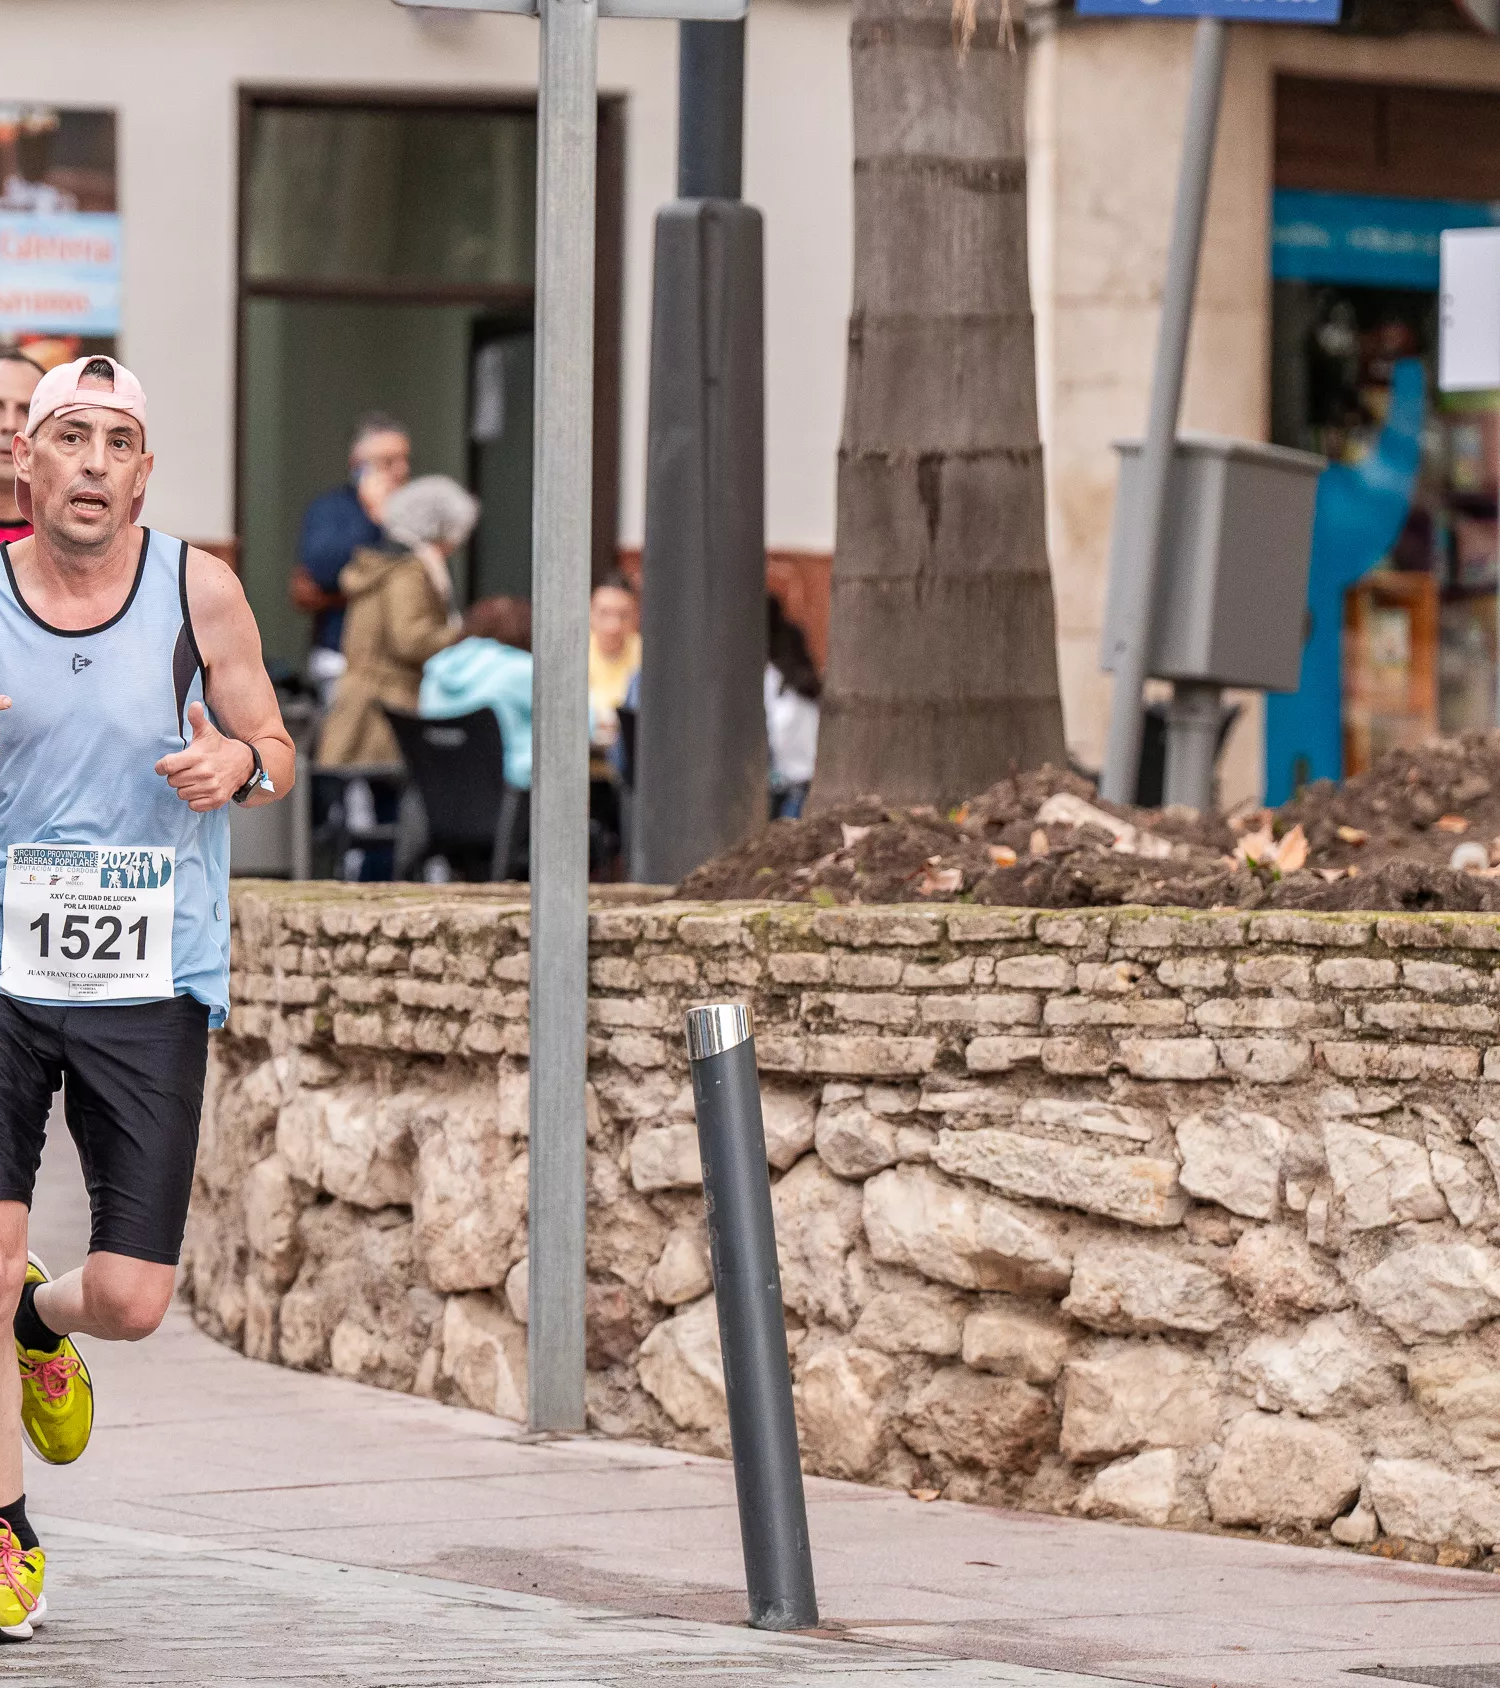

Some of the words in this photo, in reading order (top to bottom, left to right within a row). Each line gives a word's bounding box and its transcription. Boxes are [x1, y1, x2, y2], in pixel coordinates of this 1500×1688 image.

[14, 849, 45, 857] CIRCUITO
[48, 850, 88, 859] PROVINCIAL
[13, 856, 53, 866] CARRERAS
[54, 858, 98, 868] POPULARES
[100, 852, 142, 869] 2024
[30, 912, 148, 960] 1521
[46, 970, 86, 978] FRANCISCO
